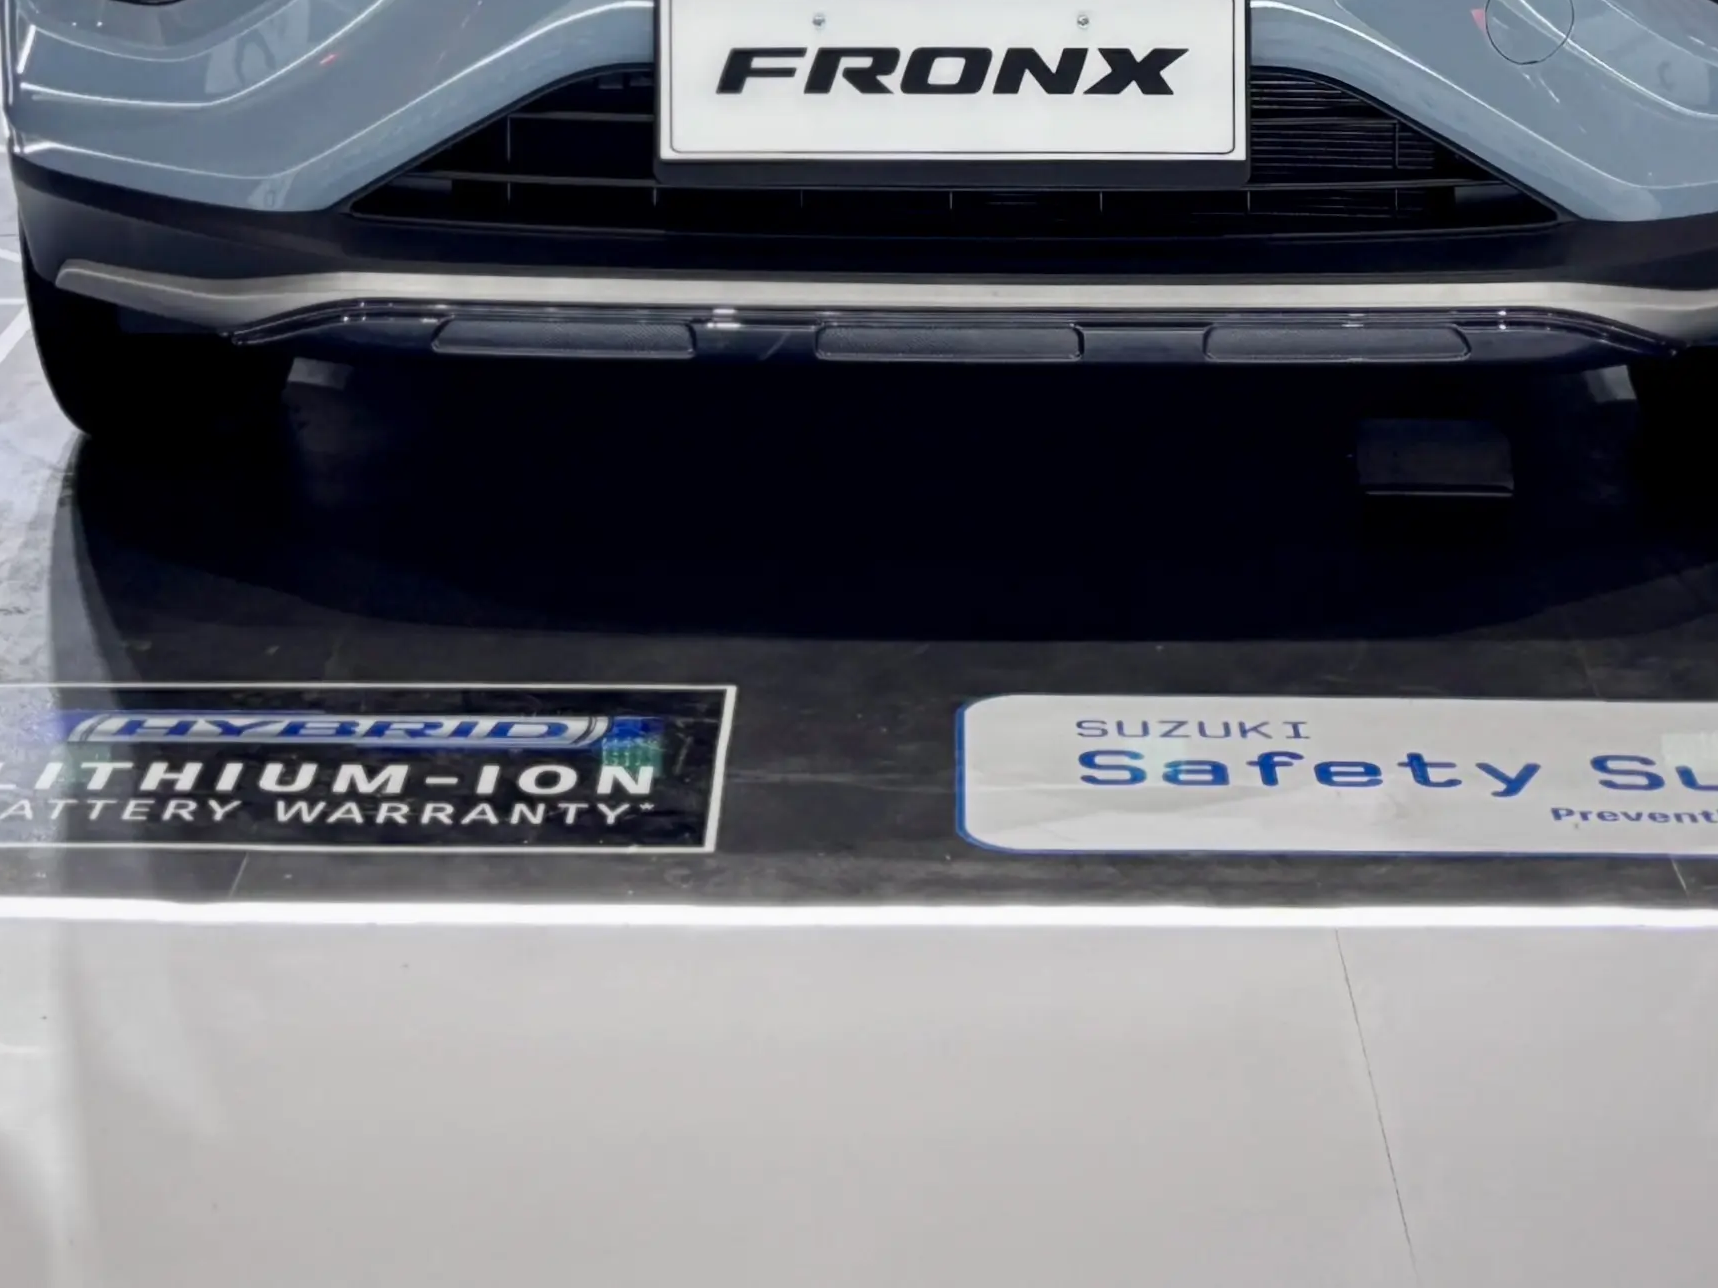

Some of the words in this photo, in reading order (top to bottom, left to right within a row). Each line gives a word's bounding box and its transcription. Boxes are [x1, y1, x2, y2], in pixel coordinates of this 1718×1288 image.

[714, 46, 1190, 96] FRONX
[112, 719, 570, 739] HYBRID
[1074, 719, 1312, 741] SUZUKI
[1077, 748, 1542, 798] Safety
